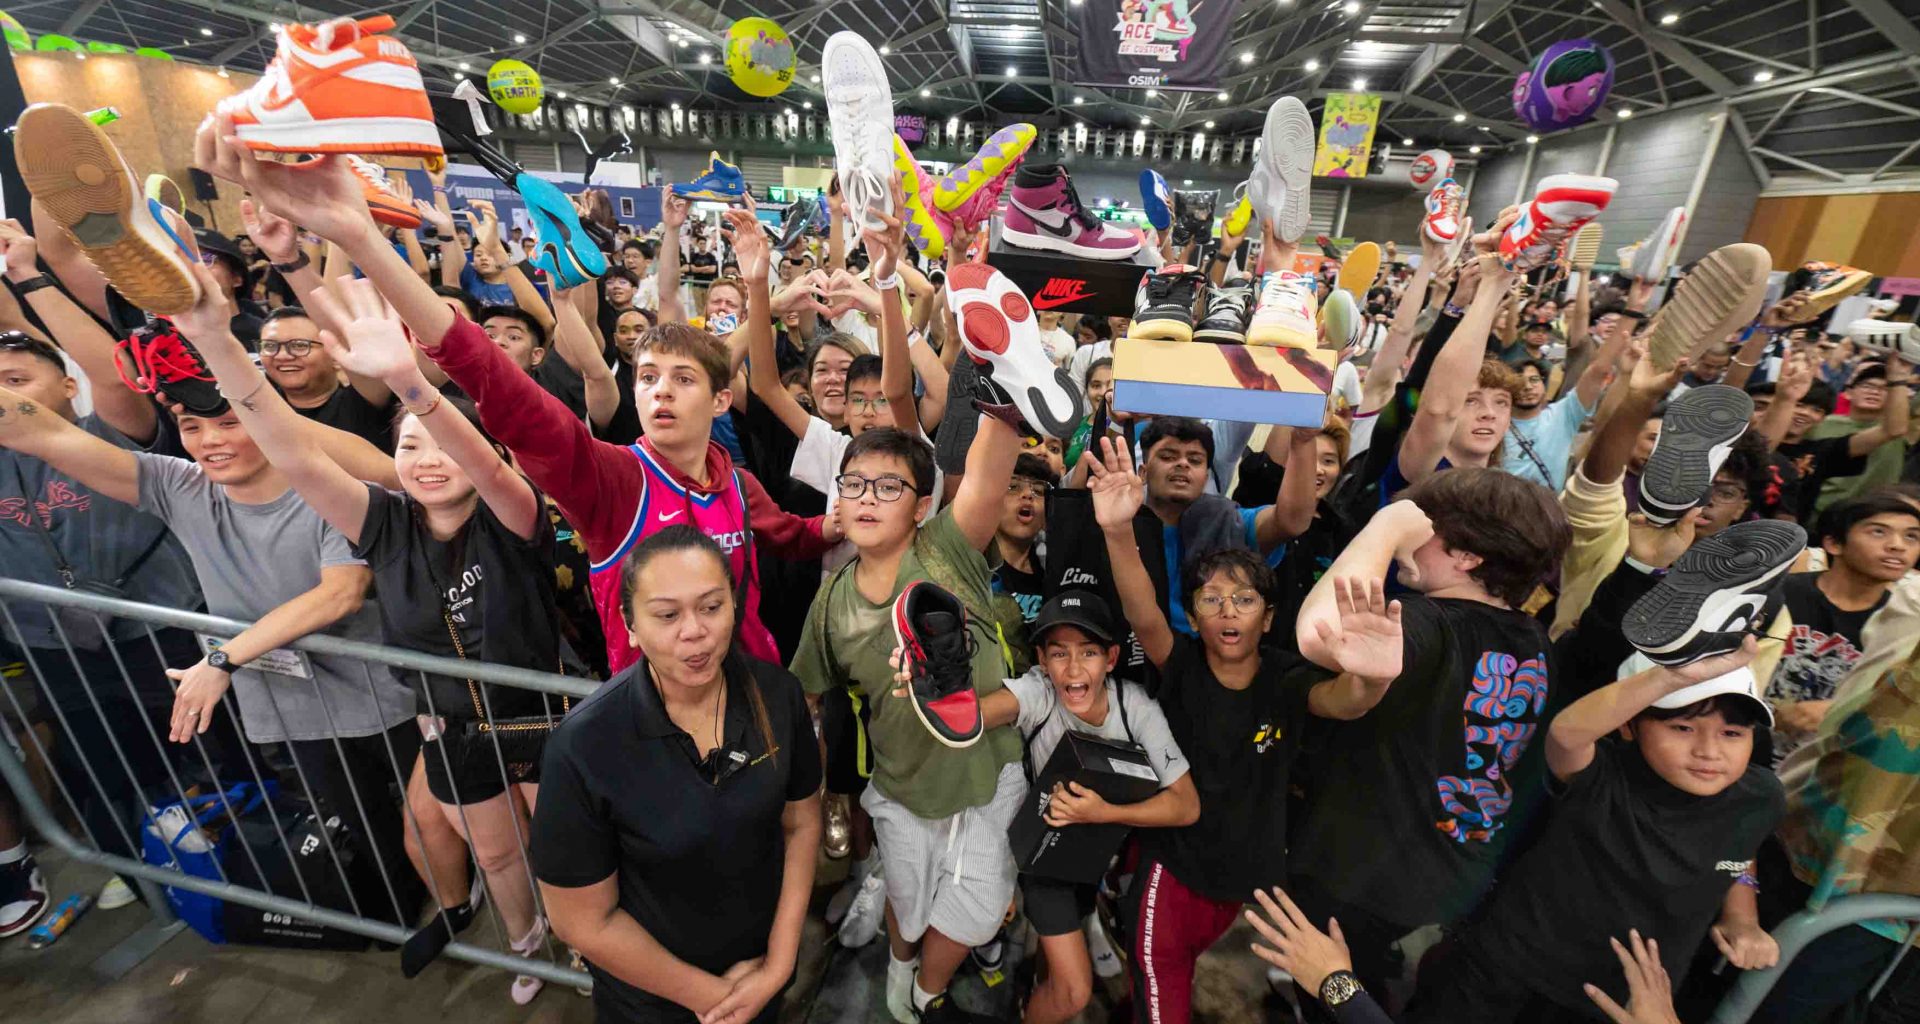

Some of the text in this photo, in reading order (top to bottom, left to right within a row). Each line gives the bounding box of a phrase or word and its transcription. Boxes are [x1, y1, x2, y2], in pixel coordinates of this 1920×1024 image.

[1124, 24, 1154, 38] ACE
[1135, 45, 1170, 53] CUSTOMS
[1128, 75, 1160, 86] OSIM
[505, 86, 537, 98] EARTH
[455, 186, 494, 200] PUMA
[1042, 277, 1087, 297] NIKE
[1060, 567, 1098, 586] Lim
[1151, 863, 1163, 888] SPIRIT
[1147, 887, 1157, 907] NEW
[1145, 908, 1154, 935] SPIRIT
[1144, 934, 1152, 955] NEW
